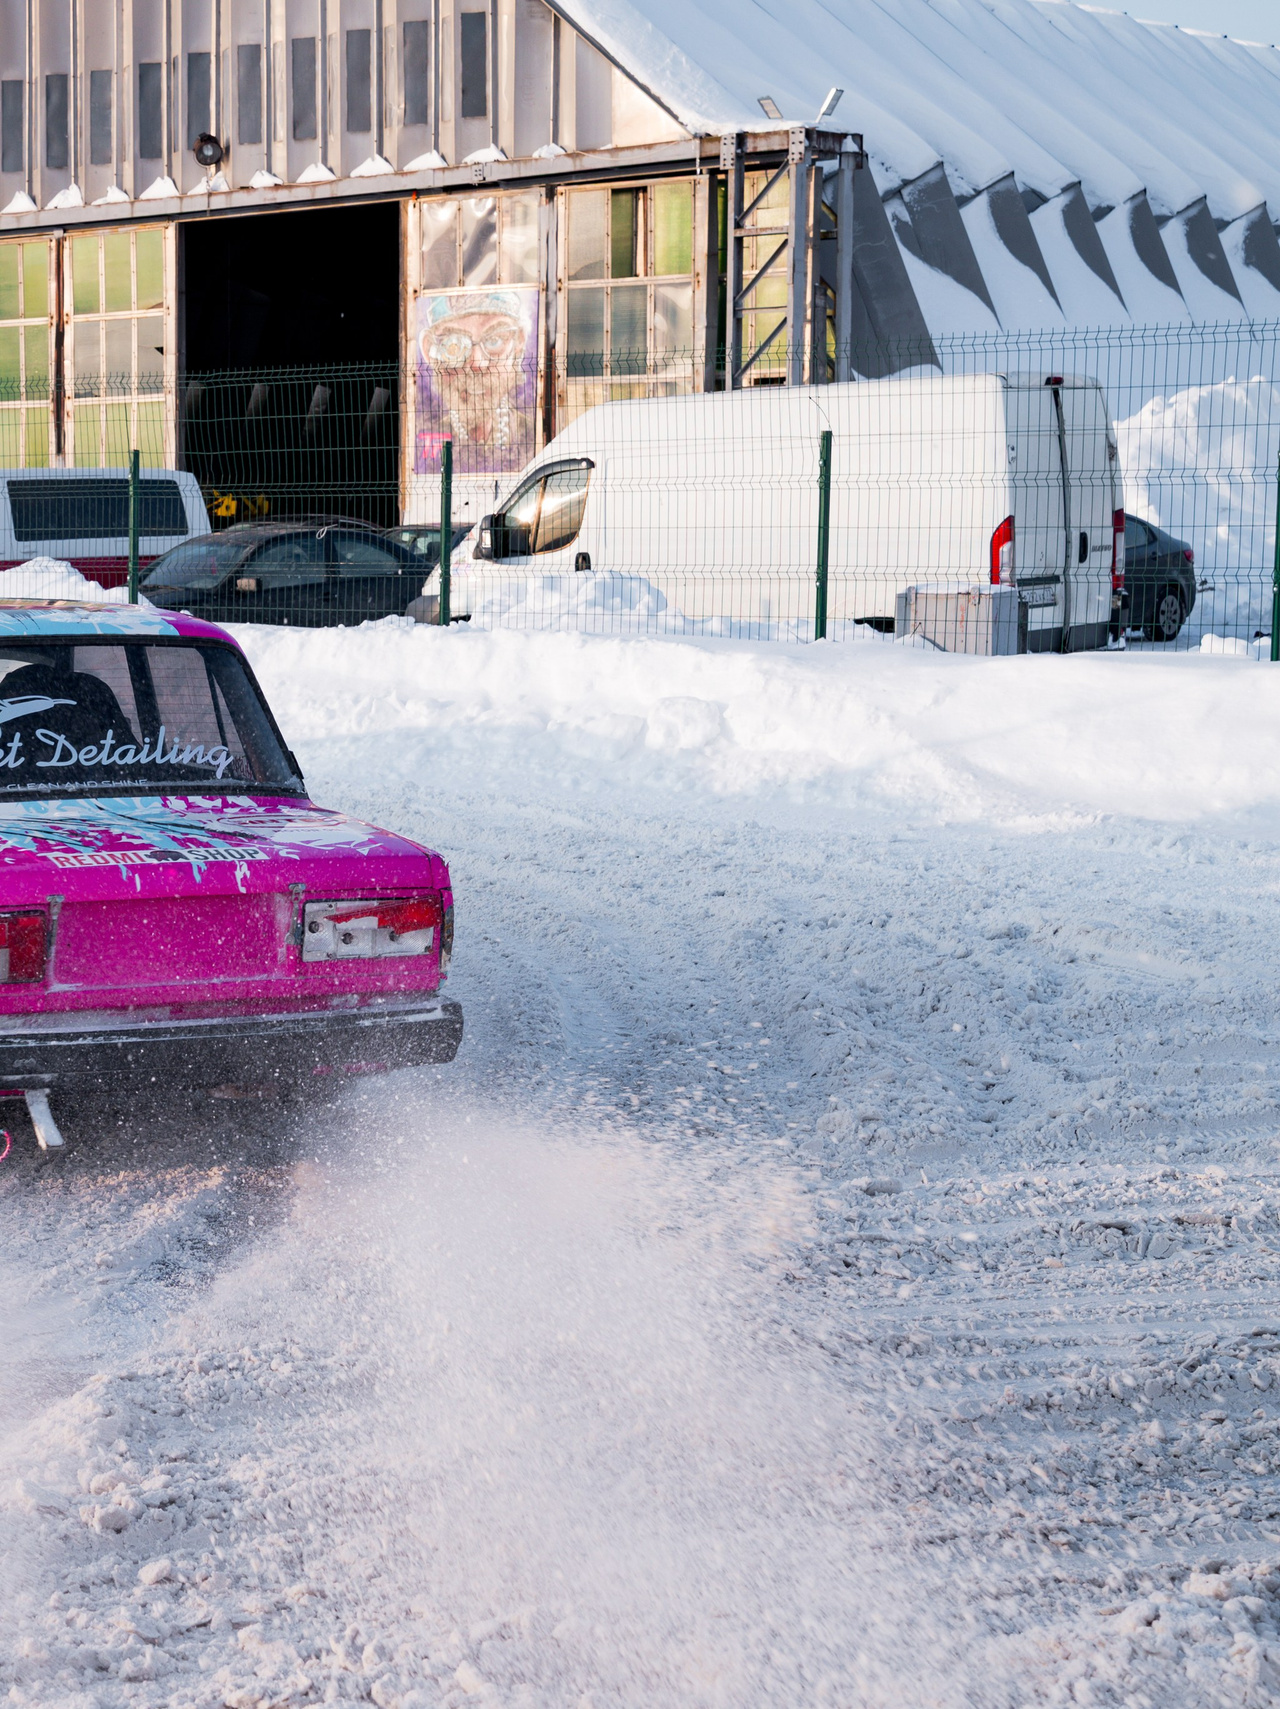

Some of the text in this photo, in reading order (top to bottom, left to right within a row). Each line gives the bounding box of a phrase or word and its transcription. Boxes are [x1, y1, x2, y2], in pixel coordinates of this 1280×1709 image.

[35, 725, 234, 779] Detailing
[6, 782, 60, 791] CLEAN
[64, 780, 98, 789] AND
[52, 847, 261, 867] REDMI SHOP
